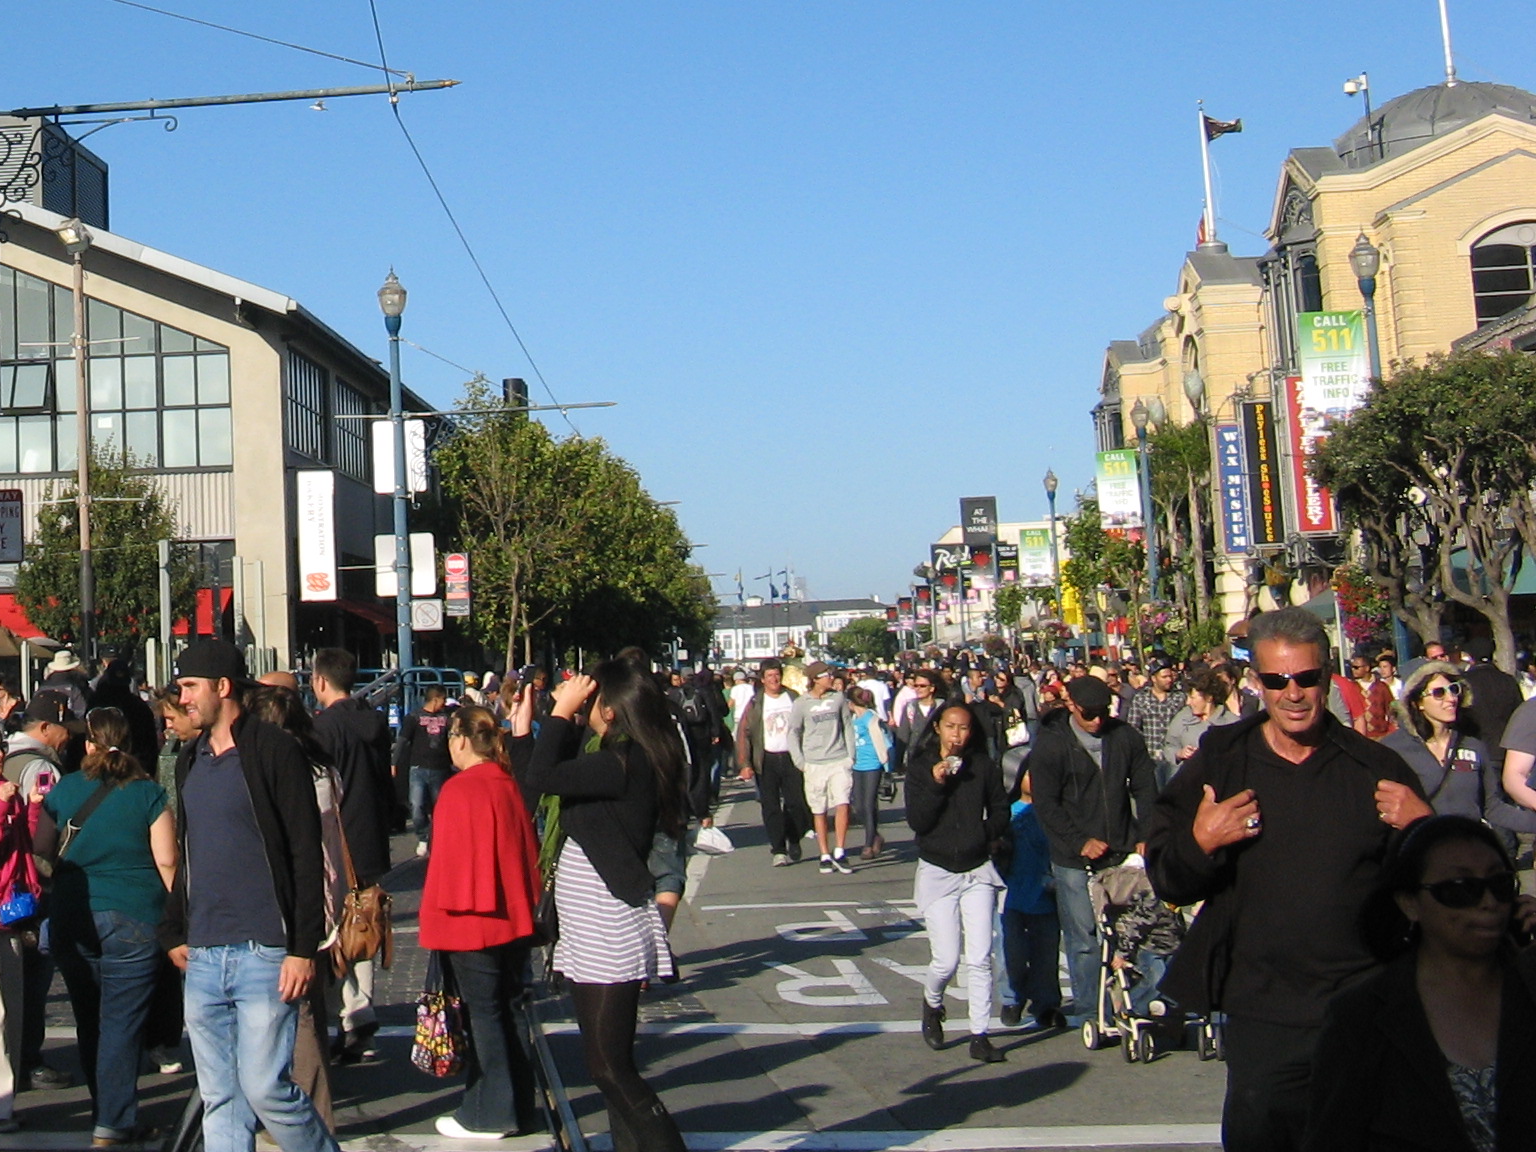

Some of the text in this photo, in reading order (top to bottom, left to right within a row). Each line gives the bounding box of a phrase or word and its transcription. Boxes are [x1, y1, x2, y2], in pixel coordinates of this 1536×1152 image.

[1313, 315, 1347, 327] CALL
[1311, 328, 1354, 352] 511
[1320, 361, 1349, 373] FREE
[1312, 374, 1359, 386] TRAFFIC
[1323, 388, 1350, 399] INFO
[1104, 453, 1126, 461] CALL
[1104, 461, 1131, 477] 511
[1222, 431, 1247, 547] WAX MUSEUM
[971, 517, 987, 525] THE
